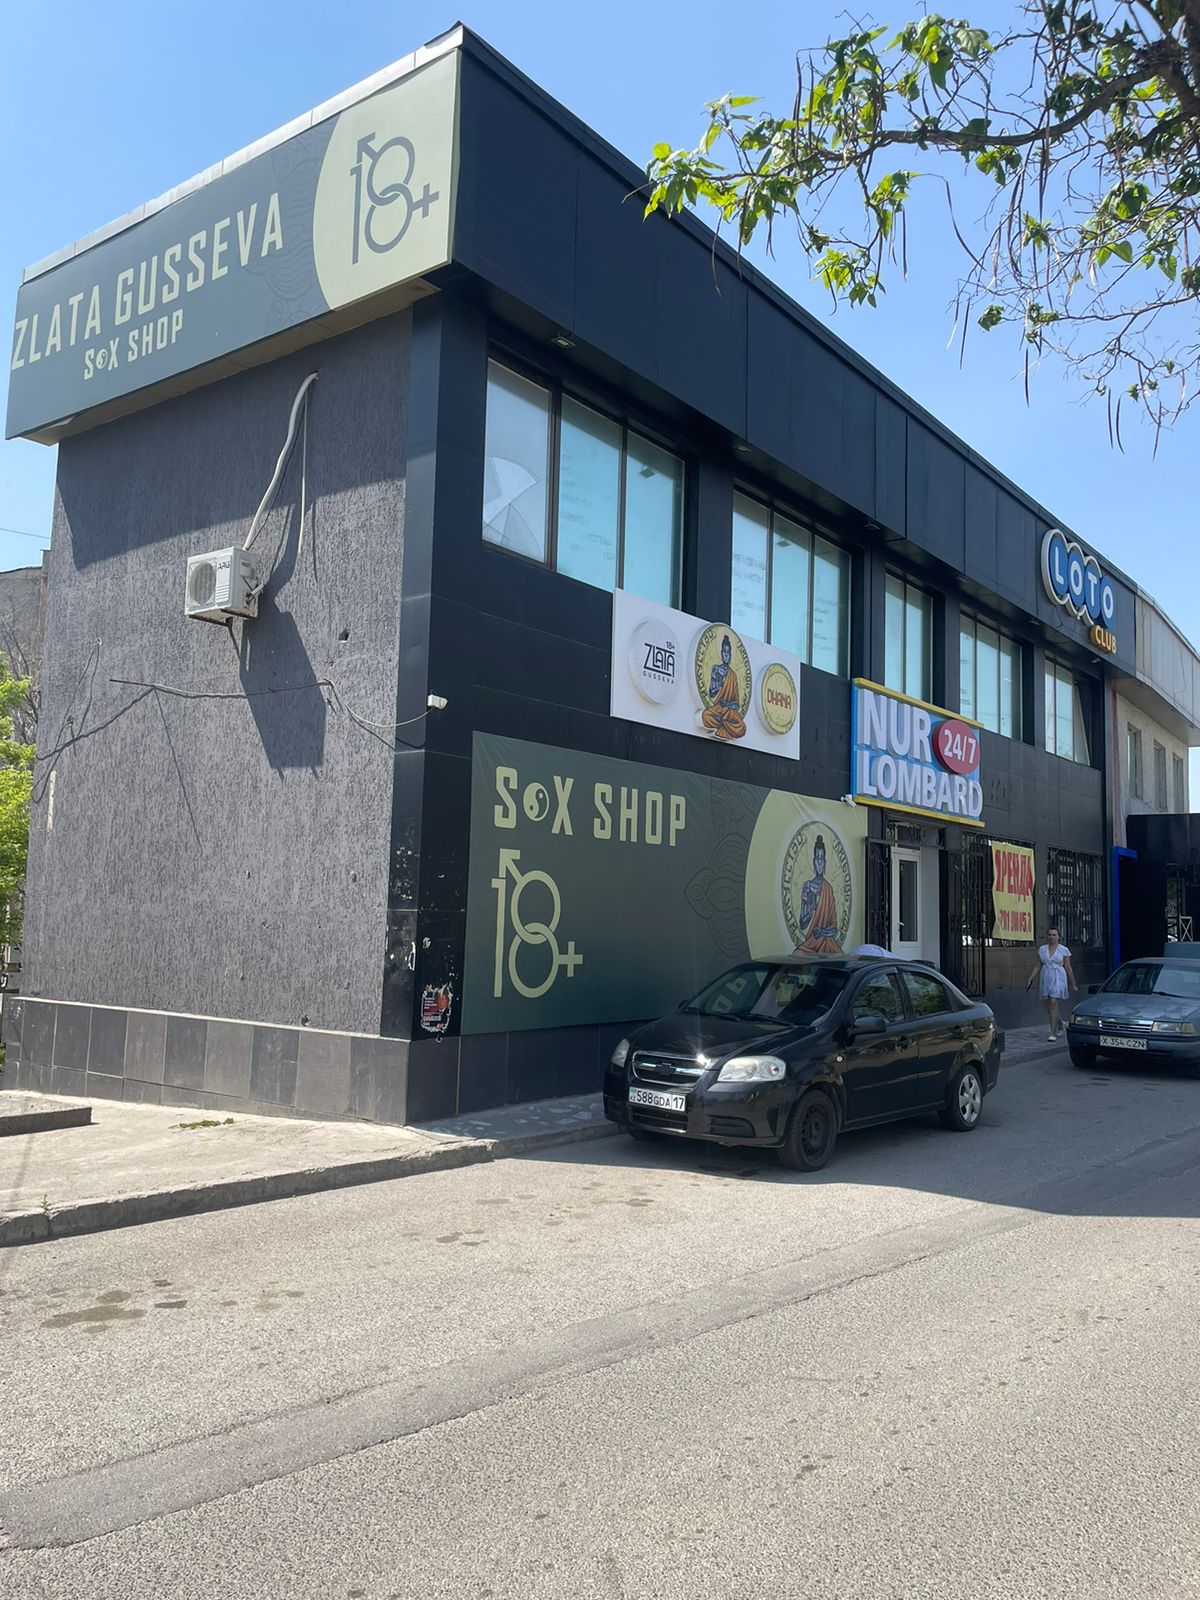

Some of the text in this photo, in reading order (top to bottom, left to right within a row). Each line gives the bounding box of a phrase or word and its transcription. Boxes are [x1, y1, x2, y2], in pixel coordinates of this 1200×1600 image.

[11, 192, 283, 371] ZLATA GUSSEVA
[128, 308, 184, 363] SHOP
[1055, 546, 1114, 620] LOTO
[643, 642, 676, 678] ZLATA
[1093, 624, 1117, 654] CLUB
[643, 670, 675, 684] GUSSEVA
[858, 688, 977, 764] NUR 24/7
[858, 750, 984, 817] LOMBARD
[593, 782, 687, 847] SHOP
[673, 1097, 685, 1109] 17
